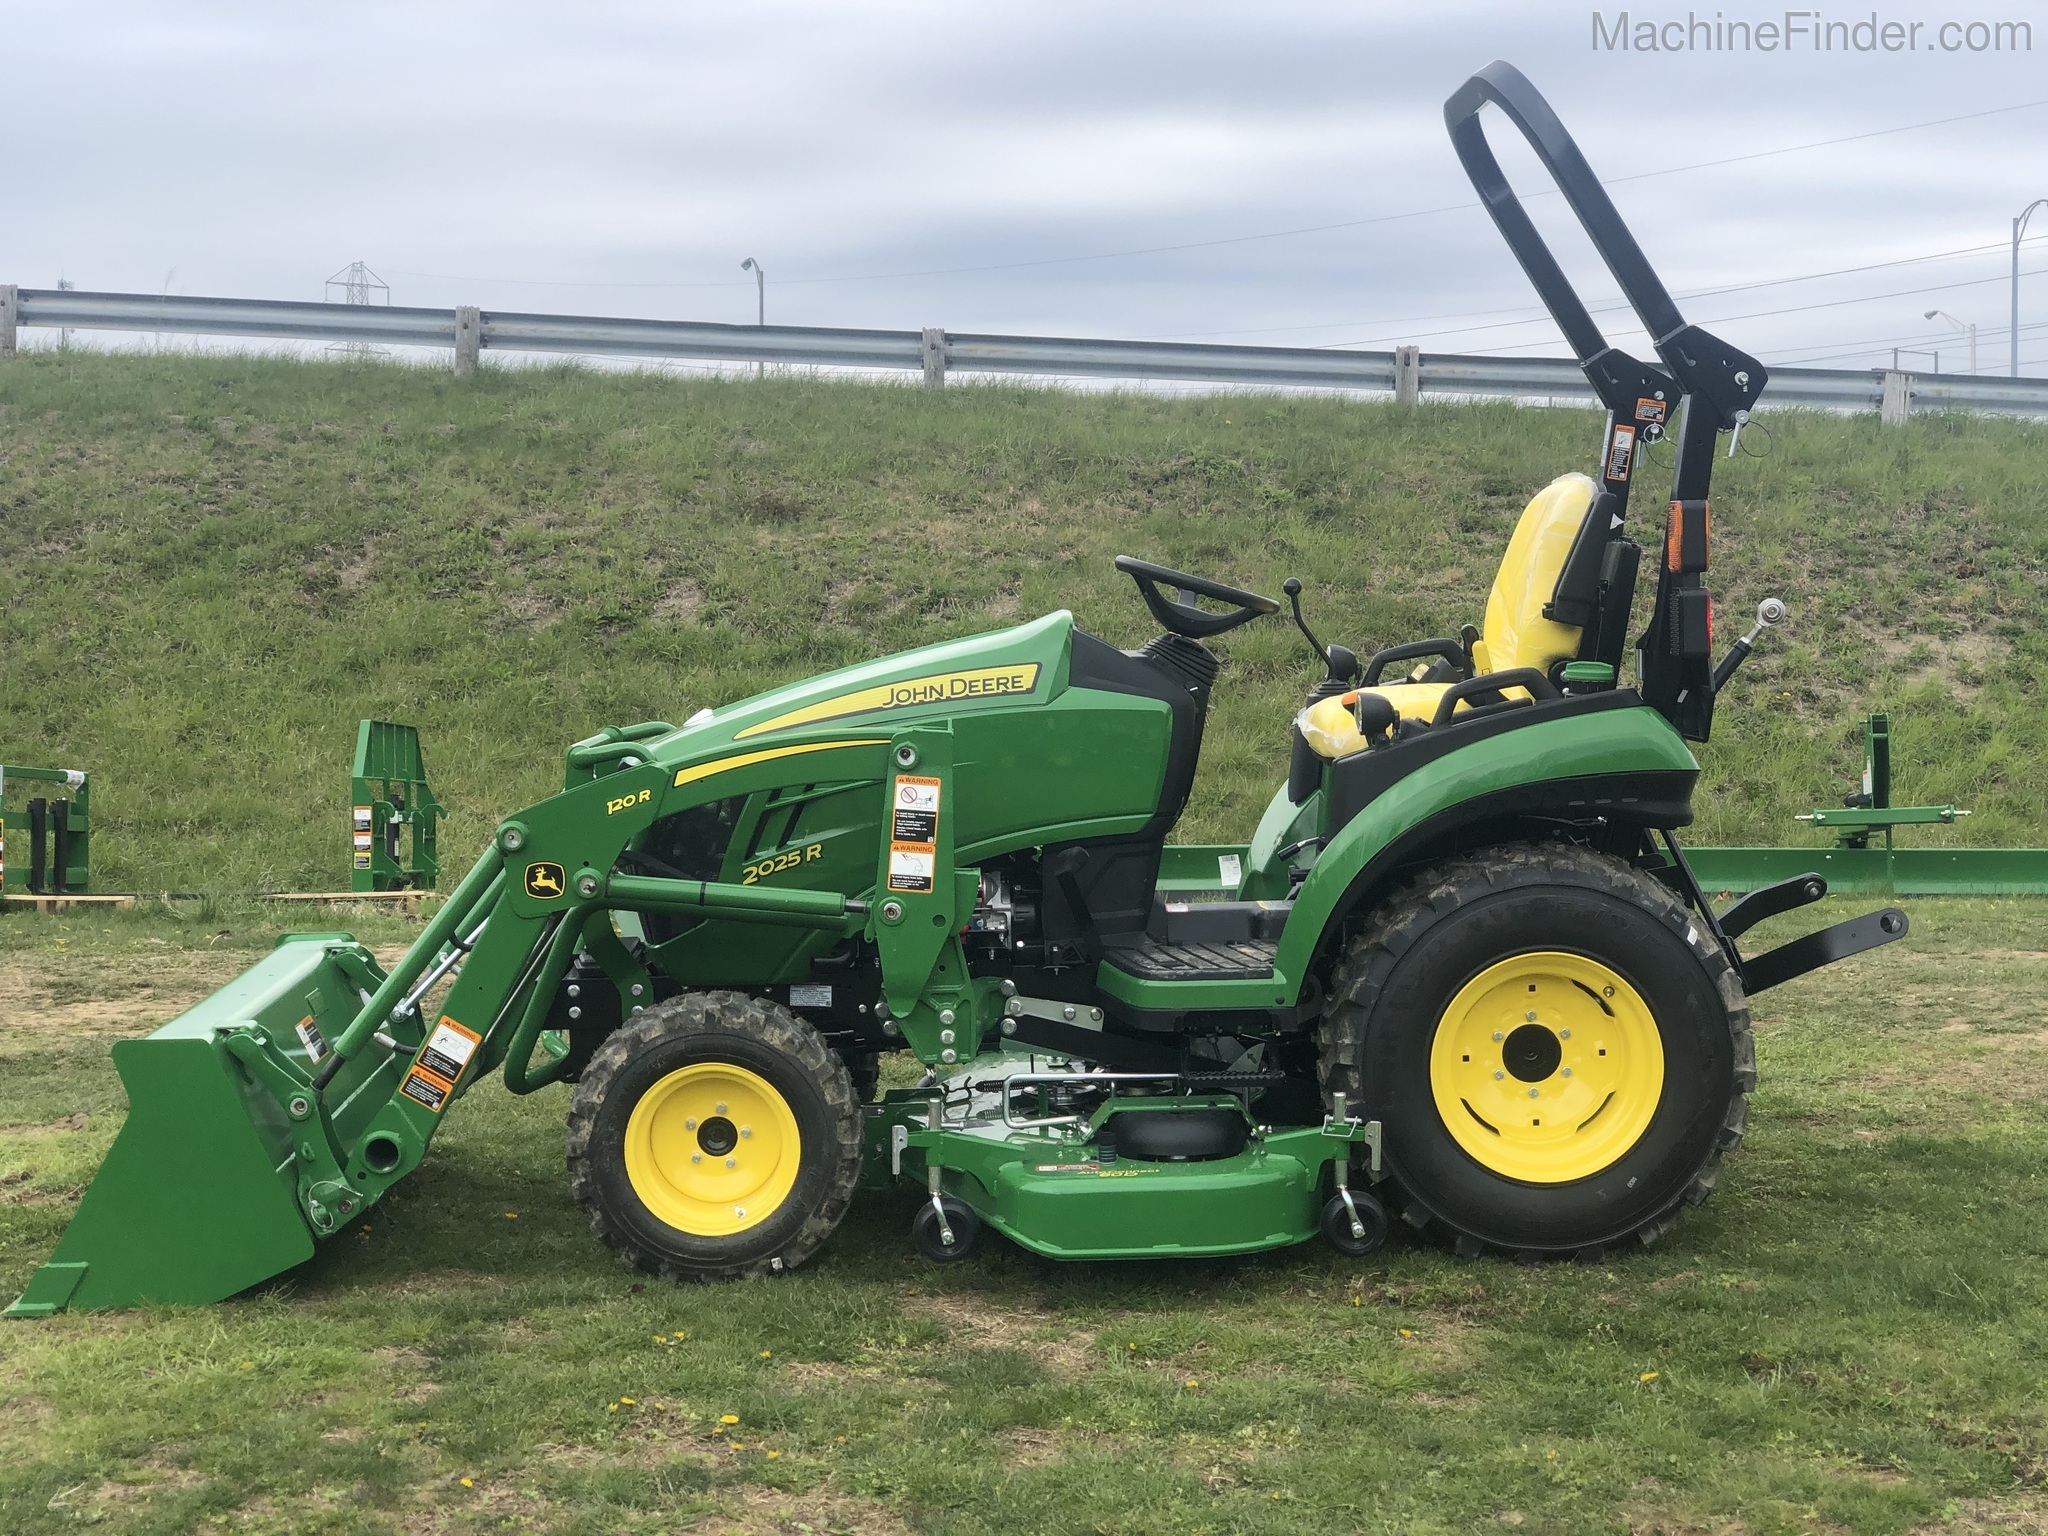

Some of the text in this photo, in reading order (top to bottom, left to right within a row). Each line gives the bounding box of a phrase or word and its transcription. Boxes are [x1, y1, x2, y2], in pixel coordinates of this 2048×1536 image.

[882, 674, 1024, 706] JOHN DEERE
[904, 777, 939, 786] WARNING
[606, 789, 651, 815] 120 R
[899, 844, 933, 853] WARNING
[742, 843, 823, 886] 2025 R
